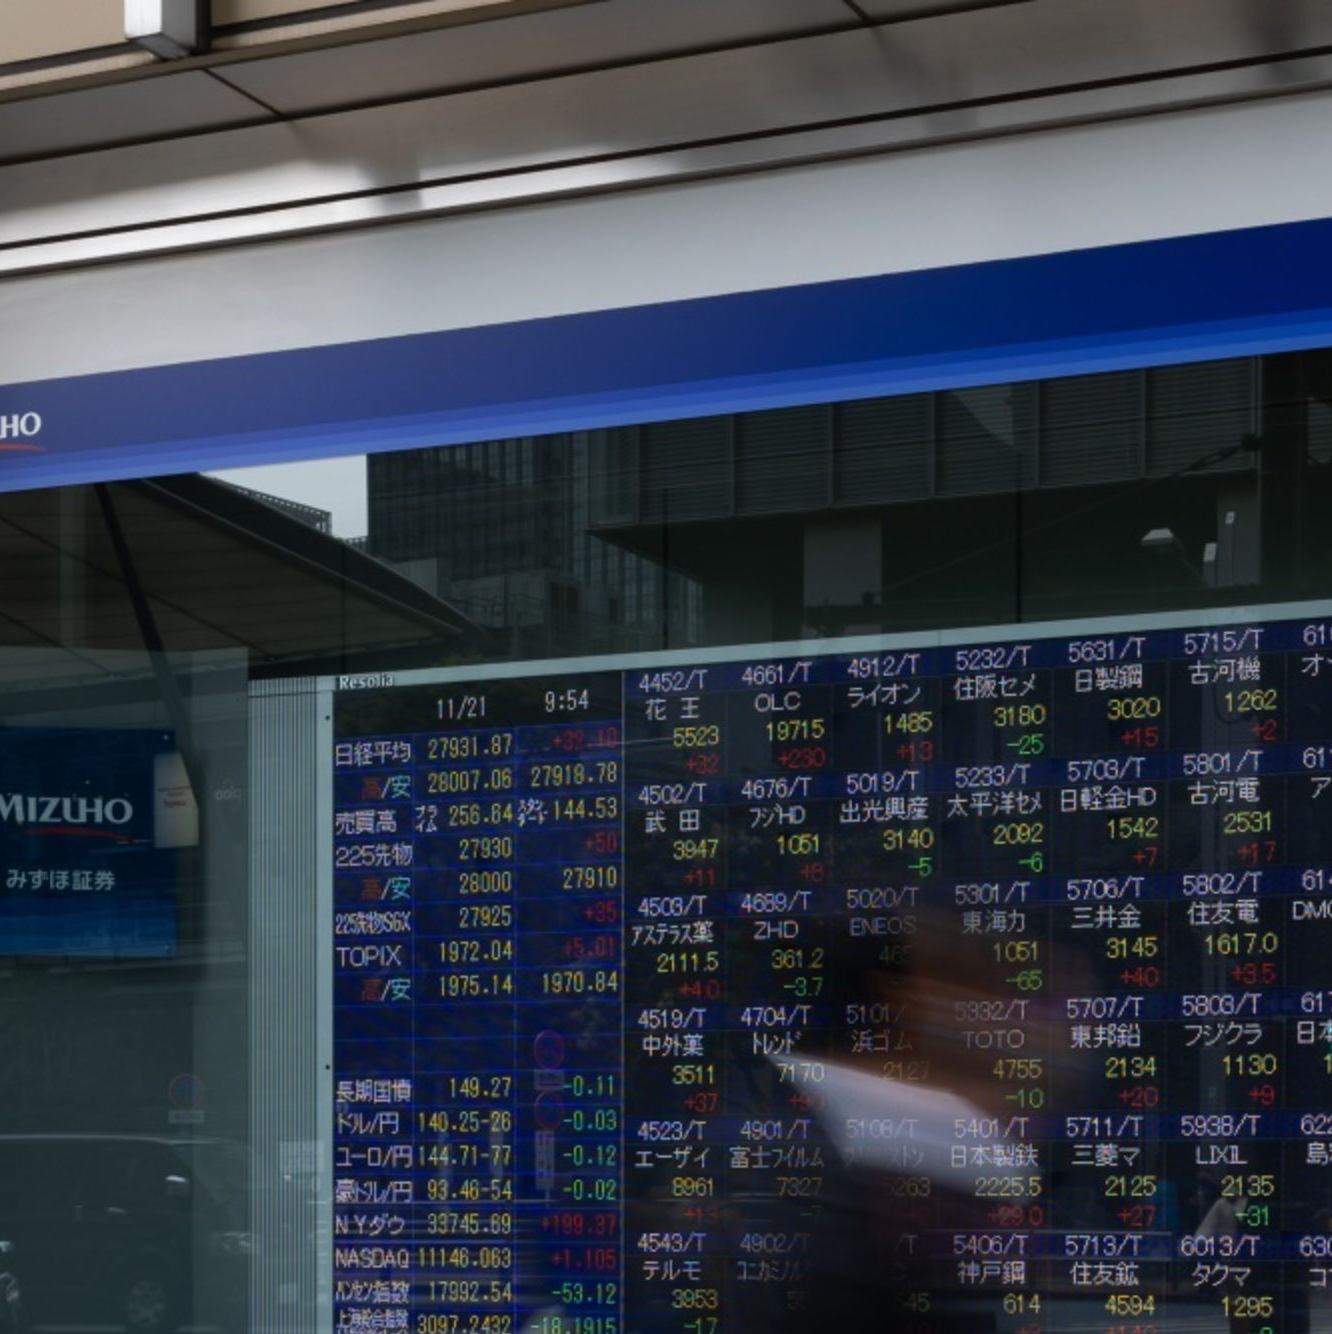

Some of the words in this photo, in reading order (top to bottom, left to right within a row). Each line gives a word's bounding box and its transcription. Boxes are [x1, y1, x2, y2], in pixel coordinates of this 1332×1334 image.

[1068, 637, 1146, 663] 5631/T
[1184, 628, 1264, 654] 5715/T
[847, 653, 921, 679] 4912/T
[955, 646, 1032, 671] 5232/T
[1188, 655, 1261, 685] 古河機
[339, 675, 394, 690] Resolia
[639, 670, 707, 692] 4452/T
[741, 661, 813, 686] 4661/T
[1075, 664, 1143, 693] 日製鋼
[847, 684, 921, 708] ライオン
[953, 673, 1036, 700] 住阪セメ
[437, 696, 486, 720] 11/21
[544, 689, 589, 712] 9:54
[754, 691, 801, 712] OLC
[335, 741, 411, 767] 日経平均
[428, 733, 513, 759] 27931.87
[1183, 749, 1263, 775] 5801/T
[428, 769, 512, 794] 28007.06
[531, 761, 617, 787] 27918.78
[955, 763, 1031, 788] 5233/T
[1068, 756, 1146, 782] 5703/T
[638, 782, 707, 804] 4502/T
[741, 776, 813, 799] 4676/T
[847, 770, 920, 794] 5019/T
[1187, 777, 1260, 805] 古河電
[839, 797, 929, 823] 出光興産
[947, 791, 1042, 818] 太平洋セメ
[1061, 786, 1157, 812] 日軽金HD
[335, 809, 397, 835] 売買高
[553, 797, 617, 820] 144.53
[335, 842, 413, 867] 225先物
[459, 837, 512, 860] 27930
[6, 869, 115, 890] みずほ証券
[459, 871, 512, 894] 28000
[563, 866, 617, 889] 27910
[1067, 876, 1145, 900] 5706/T
[1183, 871, 1262, 896] 5802/T
[741, 890, 813, 912] 4689/T
[955, 881, 1031, 905] 5301/T
[638, 895, 707, 917] 4503/T
[1071, 903, 1142, 929] 三井金
[1187, 899, 1259, 925] 住友電
[335, 911, 411, 935] 225先物SGX
[459, 905, 512, 929] 27925
[753, 920, 799, 940] ZHD
[962, 909, 1026, 934] 東海力
[336, 945, 402, 968] TOPIX
[439, 939, 513, 962] 1972.04
[1107, 937, 1157, 959] 3145
[439, 974, 513, 996] 1975.14
[542, 971, 618, 994] 1970.84
[741, 1005, 812, 1026] 4704/T
[1067, 997, 1144, 1020] 5707/T
[1182, 993, 1262, 1017] 5803/T
[637, 1007, 707, 1029] 4519/T
[643, 1034, 704, 1056] 中外薬
[1071, 1024, 1140, 1049] 東邦鉛
[1184, 1022, 1262, 1047] フジクラ
[335, 1079, 412, 1104] 長期国債
[449, 1076, 512, 1099] 149.27
[563, 1075, 615, 1096] -0.11
[337, 1111, 399, 1134] ドル/円
[419, 1111, 512, 1133] 140.25-26
[563, 1110, 617, 1131] -0.03
[637, 1120, 707, 1141] 4523/T
[740, 1120, 811, 1140] 4901/T
[954, 1116, 1029, 1139] 5401/T
[1067, 1114, 1144, 1138] 5711/T
[1181, 1113, 1261, 1137] 5938/T
[335, 1145, 413, 1168] ユーロ/円
[419, 1145, 512, 1167] 144.71-77
[563, 1145, 617, 1167] -0.12
[635, 1146, 710, 1169] エーザイ
[951, 1145, 1039, 1168] 日本製鉄
[1072, 1145, 1141, 1167] 三菱マ
[1196, 1145, 1248, 1165] LIXIL
[335, 1179, 413, 1203] 豪ドル/円
[427, 1179, 512, 1201] 93.46-54
[563, 1179, 617, 1200] -0.02
[427, 1213, 512, 1235] 33745.69
[637, 1231, 707, 1253] 4543/T
[953, 1233, 1028, 1255] 5406/T
[1065, 1234, 1142, 1256] 5713/T
[1180, 1235, 1261, 1257] 6013/T
[336, 1247, 409, 1269] NASDAQ
[419, 1246, 512, 1268] 11146.063
[642, 1260, 701, 1280] テルモ
[958, 1261, 1026, 1285] 神戸鋼
[1070, 1261, 1139, 1285] 住友鉱
[1192, 1263, 1251, 1286] タクマ
[429, 1281, 513, 1302] 17992.54
[552, 1283, 617, 1304] -53.12
